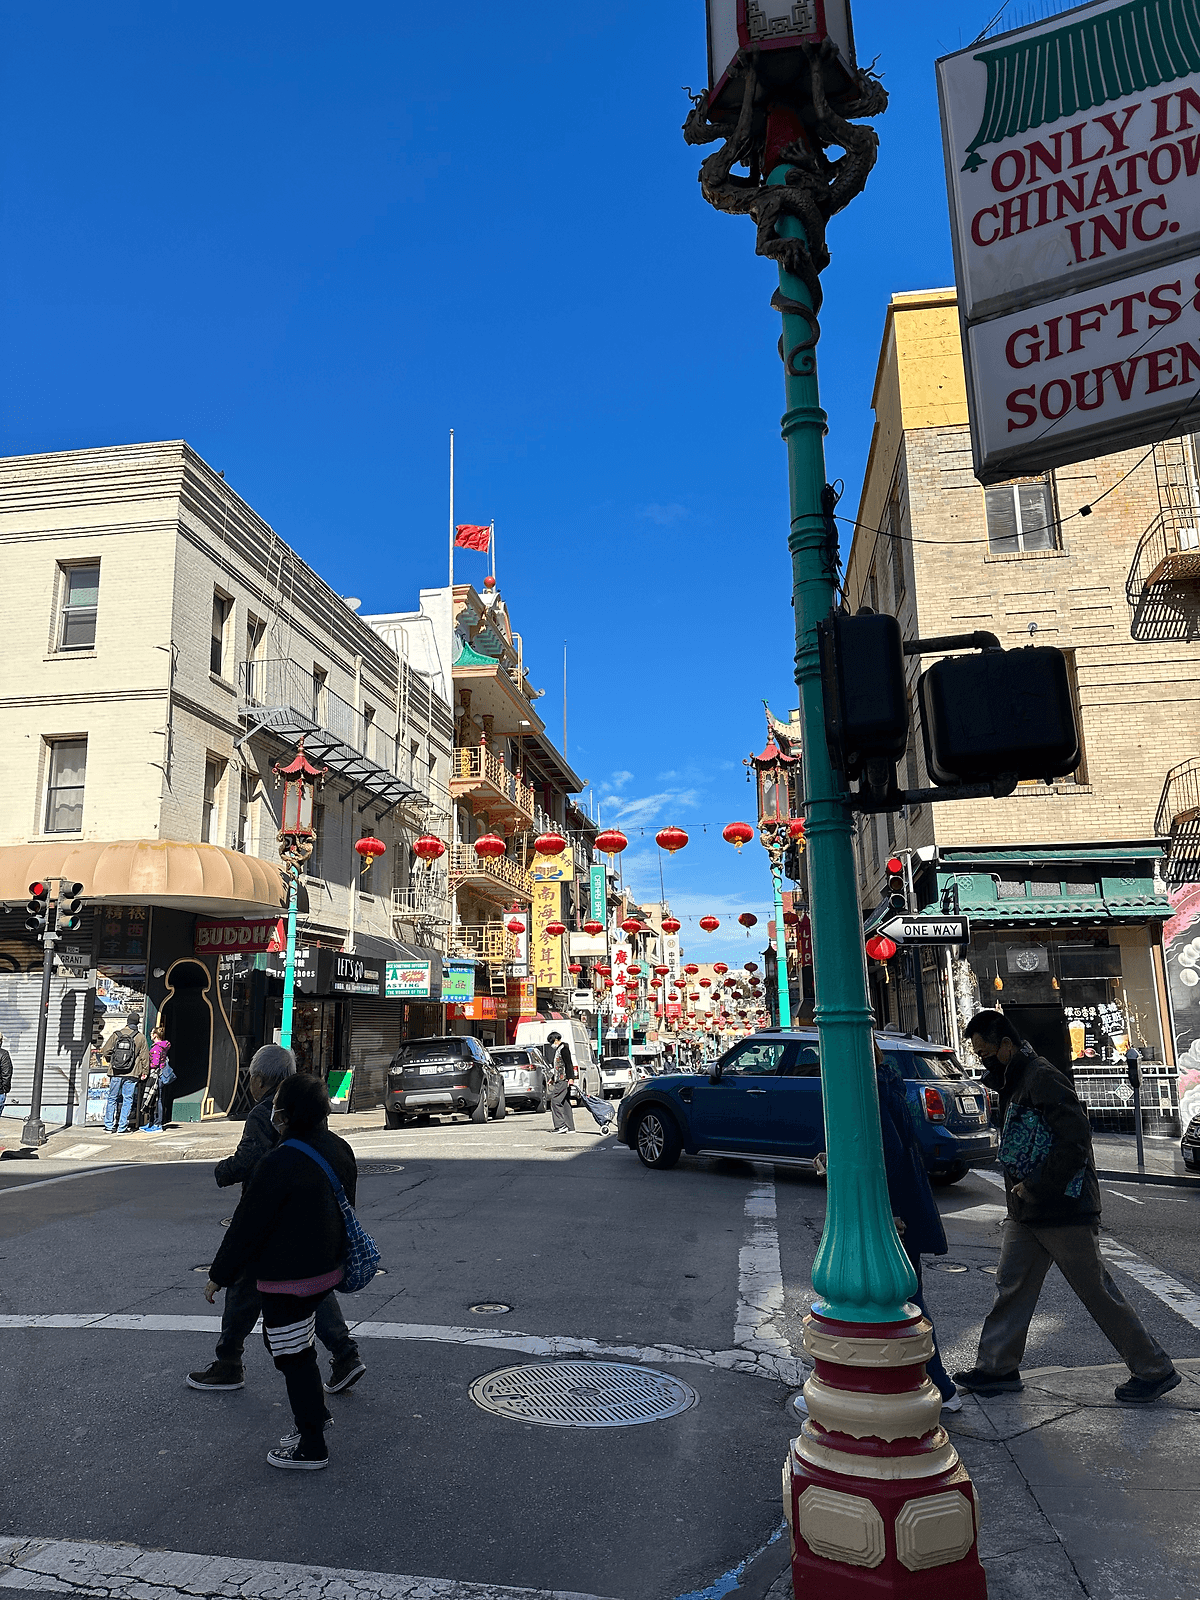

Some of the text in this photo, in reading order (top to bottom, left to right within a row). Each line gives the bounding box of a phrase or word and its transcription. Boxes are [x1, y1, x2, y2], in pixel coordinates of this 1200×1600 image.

[991, 103, 1142, 193] ONLY
[1064, 193, 1180, 267] INC.
[1005, 280, 1182, 369] GIFTS
[594, 901, 602, 919] BANK
[197, 926, 281, 946] BUDDHA
[904, 925, 959, 936] ONE WAY
[61, 955, 83, 964] GRANT
